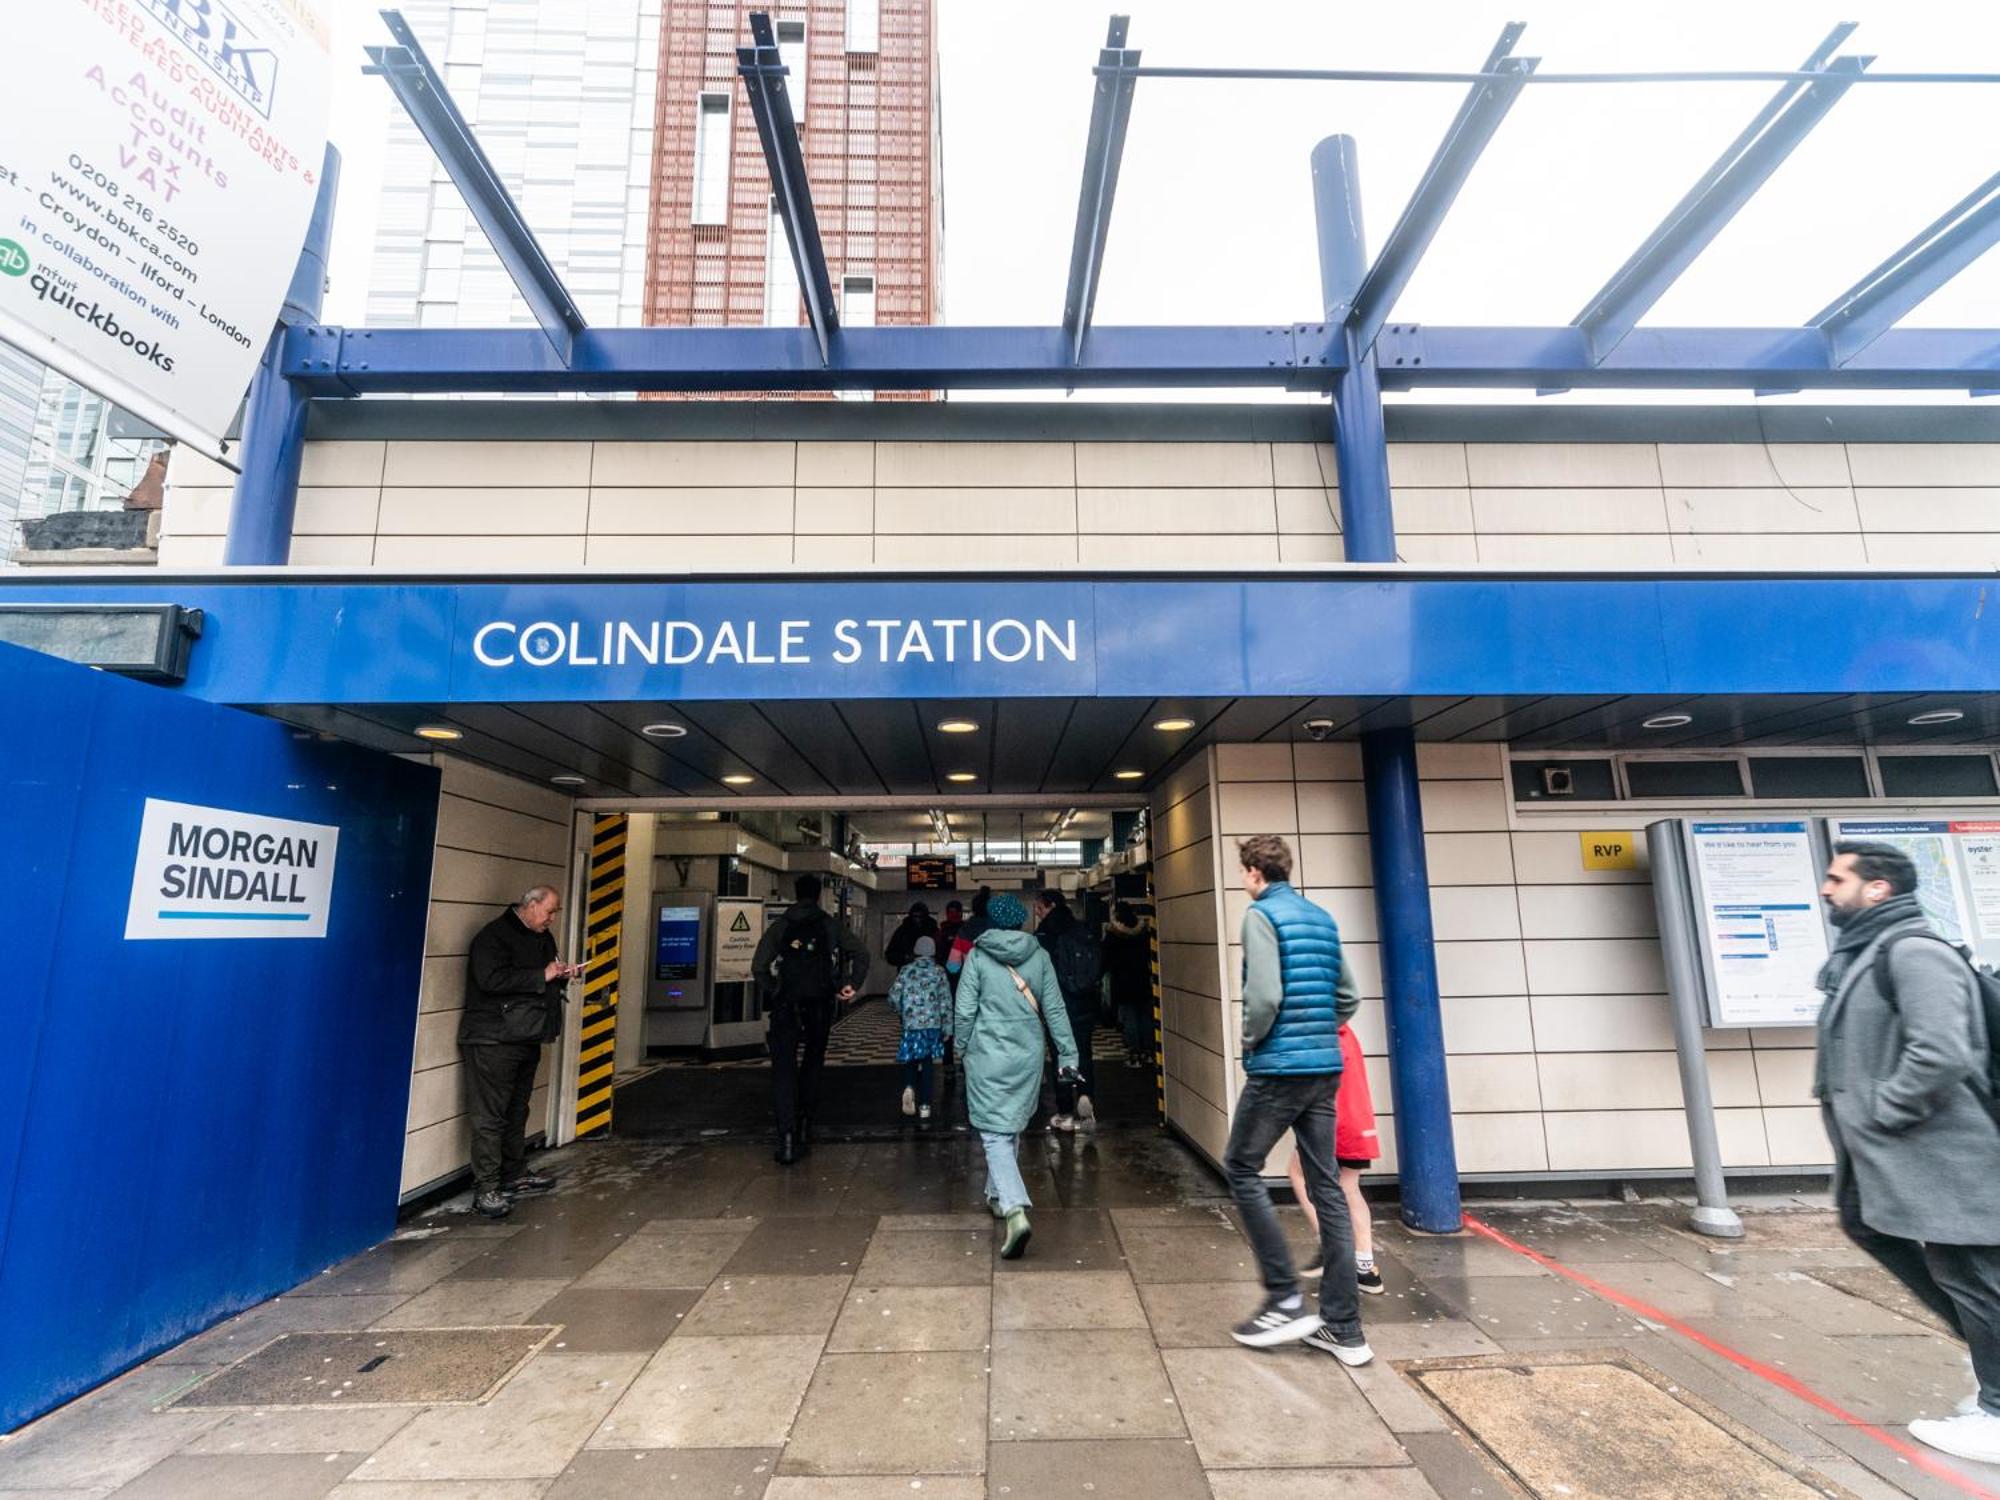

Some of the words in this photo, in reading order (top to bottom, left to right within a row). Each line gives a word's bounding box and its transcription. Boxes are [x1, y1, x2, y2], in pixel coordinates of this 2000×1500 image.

[85, 64, 229, 189] Accounts
[128, 72, 207, 144] Audit
[152, 37, 299, 170] ACCOUNTANTS
[303, 170, 315, 184] &
[190, 86, 284, 173] AUDITORS
[119, 144, 181, 203] VAT
[130, 122, 182, 179] Tax
[51, 170, 198, 284] www.bbkca.com
[68, 154, 119, 197] 0208
[122, 194, 152, 223] 216
[157, 219, 199, 256] 2520
[20, 215, 37, 235] in
[42, 232, 147, 308] collaboration
[150, 304, 181, 330] with
[37, 263, 79, 293] intuit
[39, 193, 121, 257] Croydon
[140, 262, 184, 300] Ilford
[200, 304, 252, 349] London
[30, 273, 176, 373] quickbooks
[473, 620, 811, 667] COLINDALE
[832, 619, 1077, 665] STATION
[160, 863, 307, 904] SINDALL
[167, 822, 319, 868] MORGAN
[1593, 844, 1623, 857] RVP
